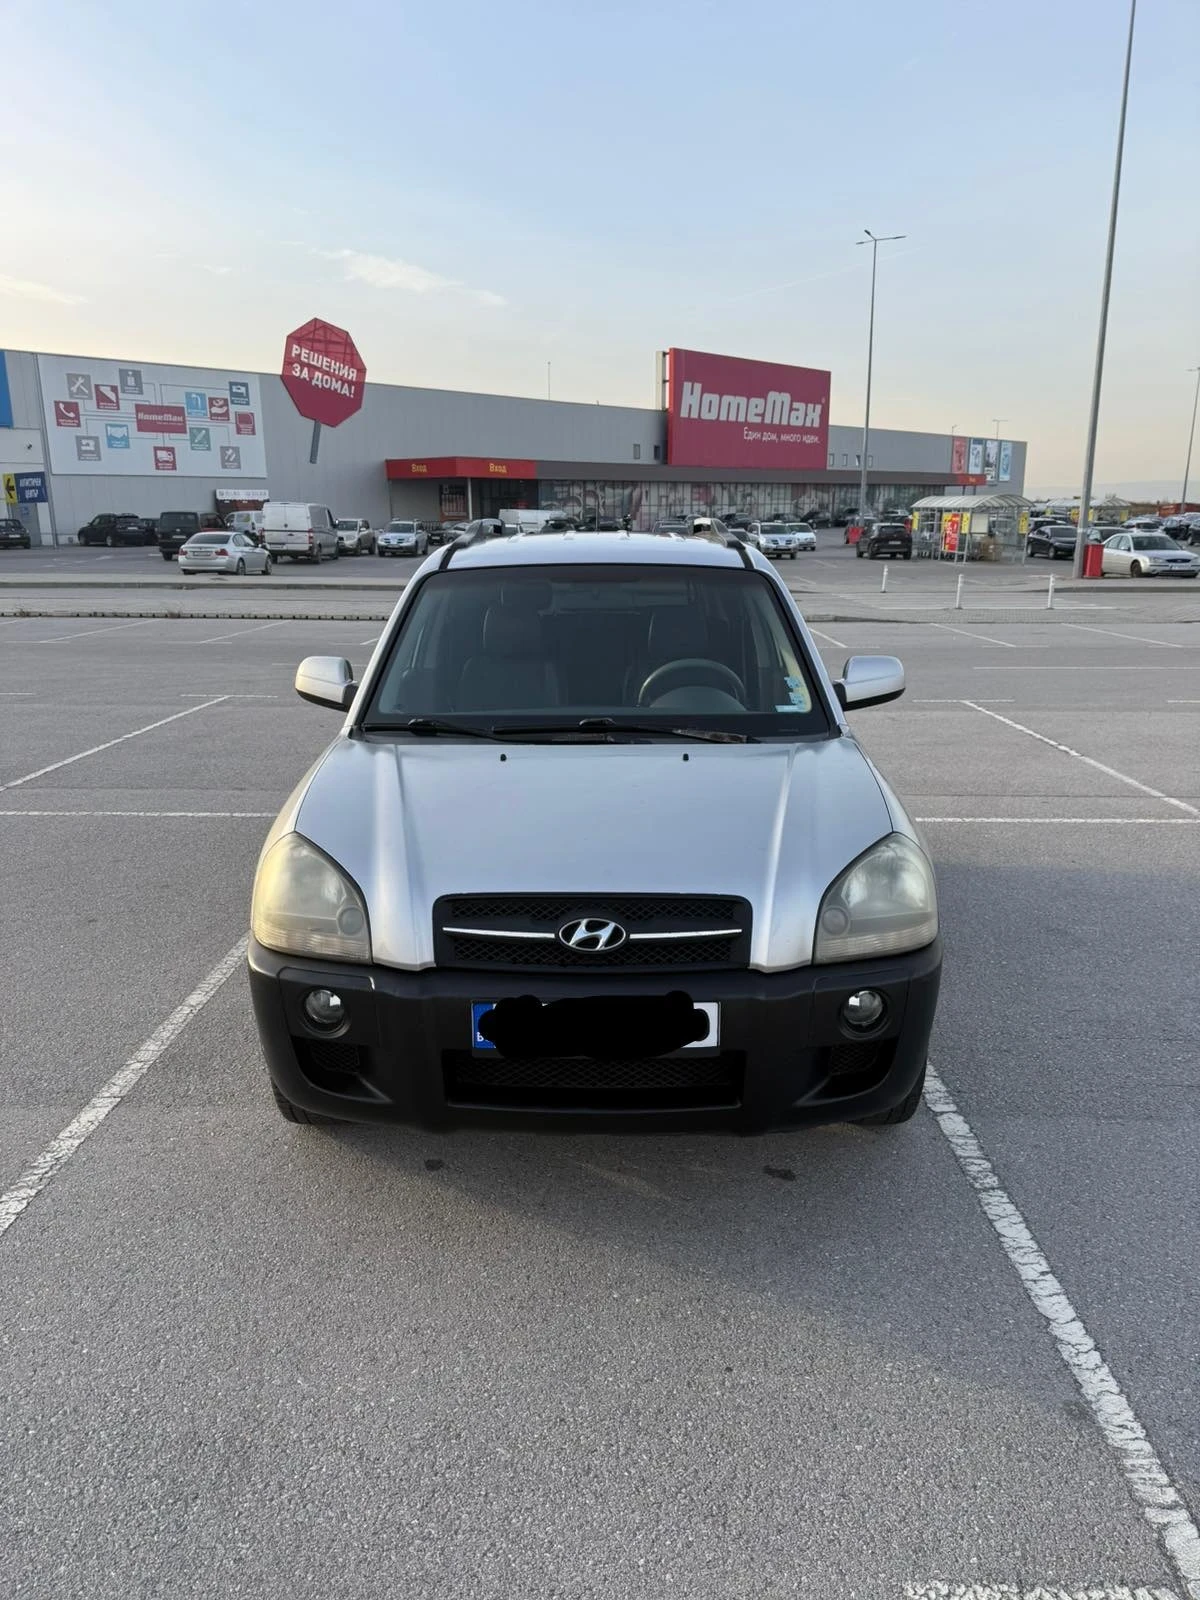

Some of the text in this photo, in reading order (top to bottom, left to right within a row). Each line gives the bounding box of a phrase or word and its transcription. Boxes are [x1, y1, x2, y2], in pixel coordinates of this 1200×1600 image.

[291, 344, 357, 382] РЕШЕНИЯ
[291, 363, 355, 399] ЗА ДОМА!
[680, 381, 822, 428] HomeMax
[743, 426, 761, 443] Един
[780, 432, 801, 443] много
[489, 463, 507, 474] Вход
